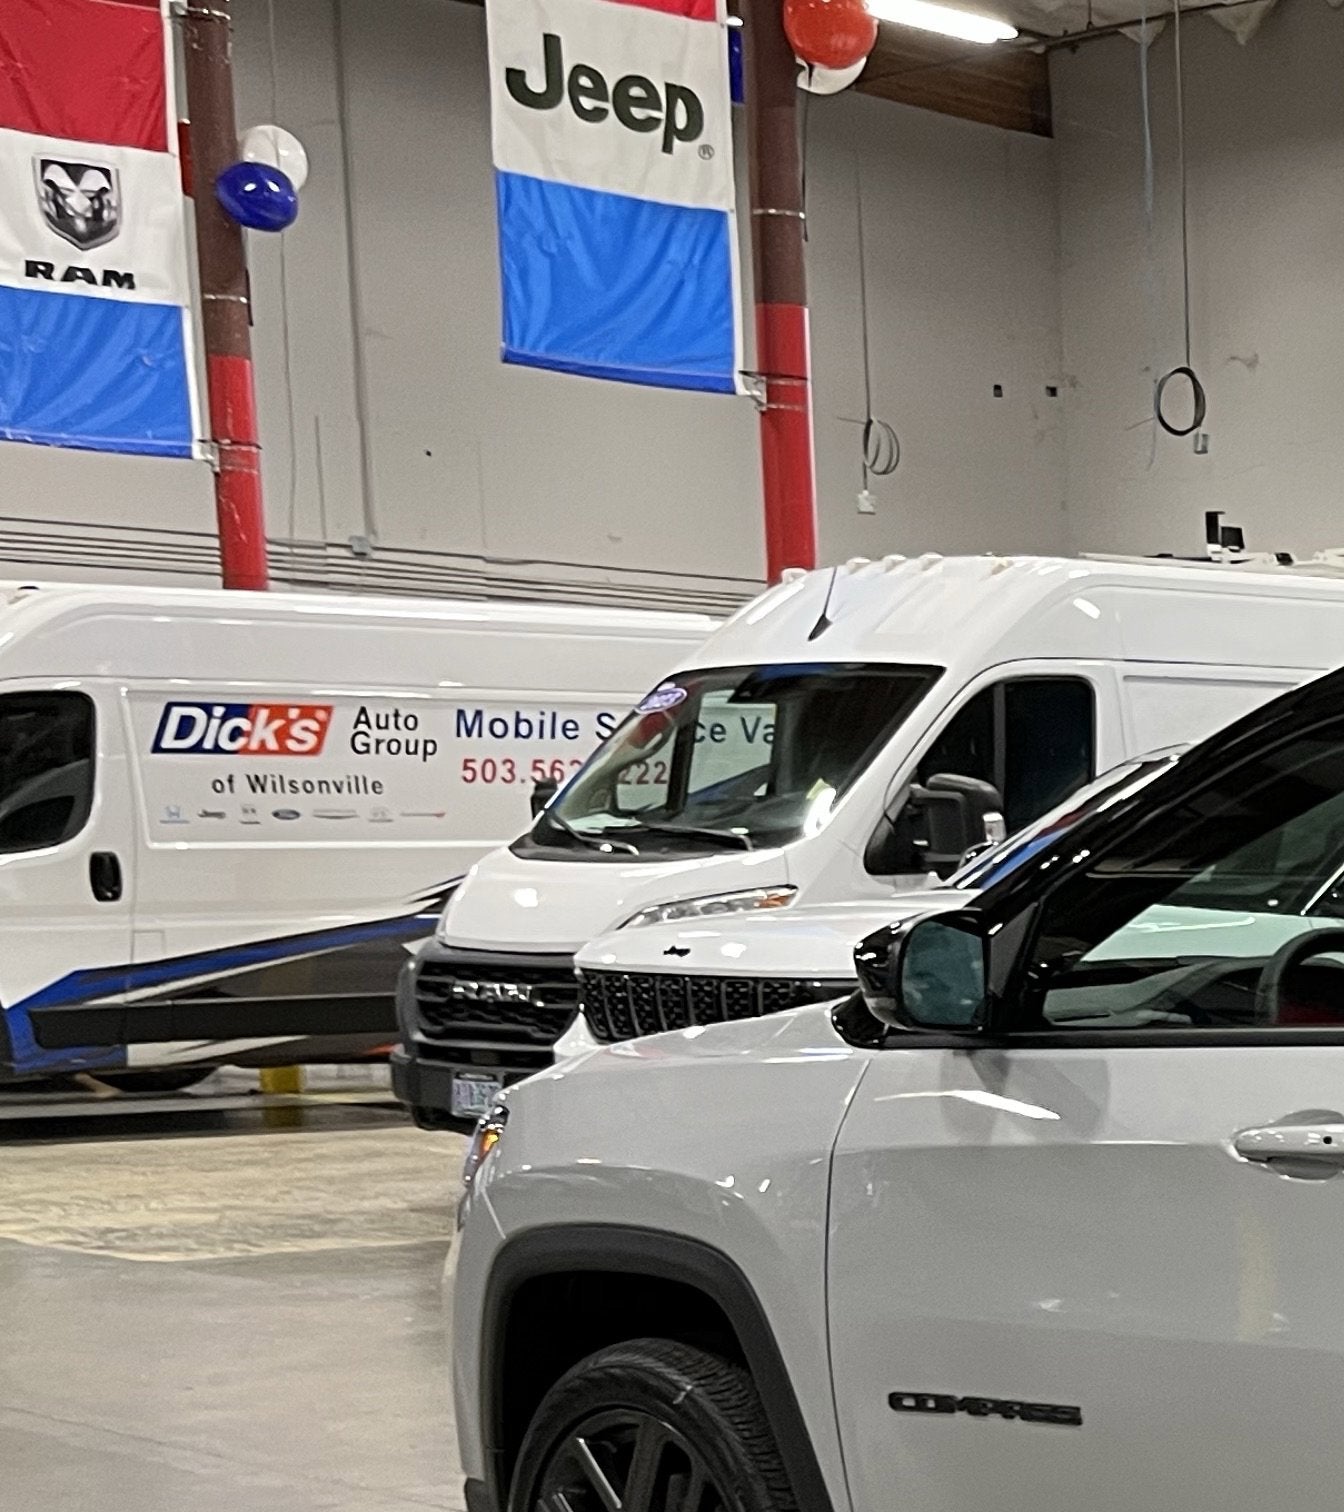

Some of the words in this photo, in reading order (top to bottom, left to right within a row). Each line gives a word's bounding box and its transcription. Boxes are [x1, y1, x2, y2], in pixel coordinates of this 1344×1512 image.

[505, 33, 704, 154] Jeep
[24, 259, 136, 290] RAM
[160, 706, 320, 752] Dick's
[353, 706, 418, 731] Auto
[455, 709, 580, 740] Mobile
[350, 731, 438, 762] Group
[212, 774, 235, 794] of
[246, 773, 384, 795] Wilsonville
